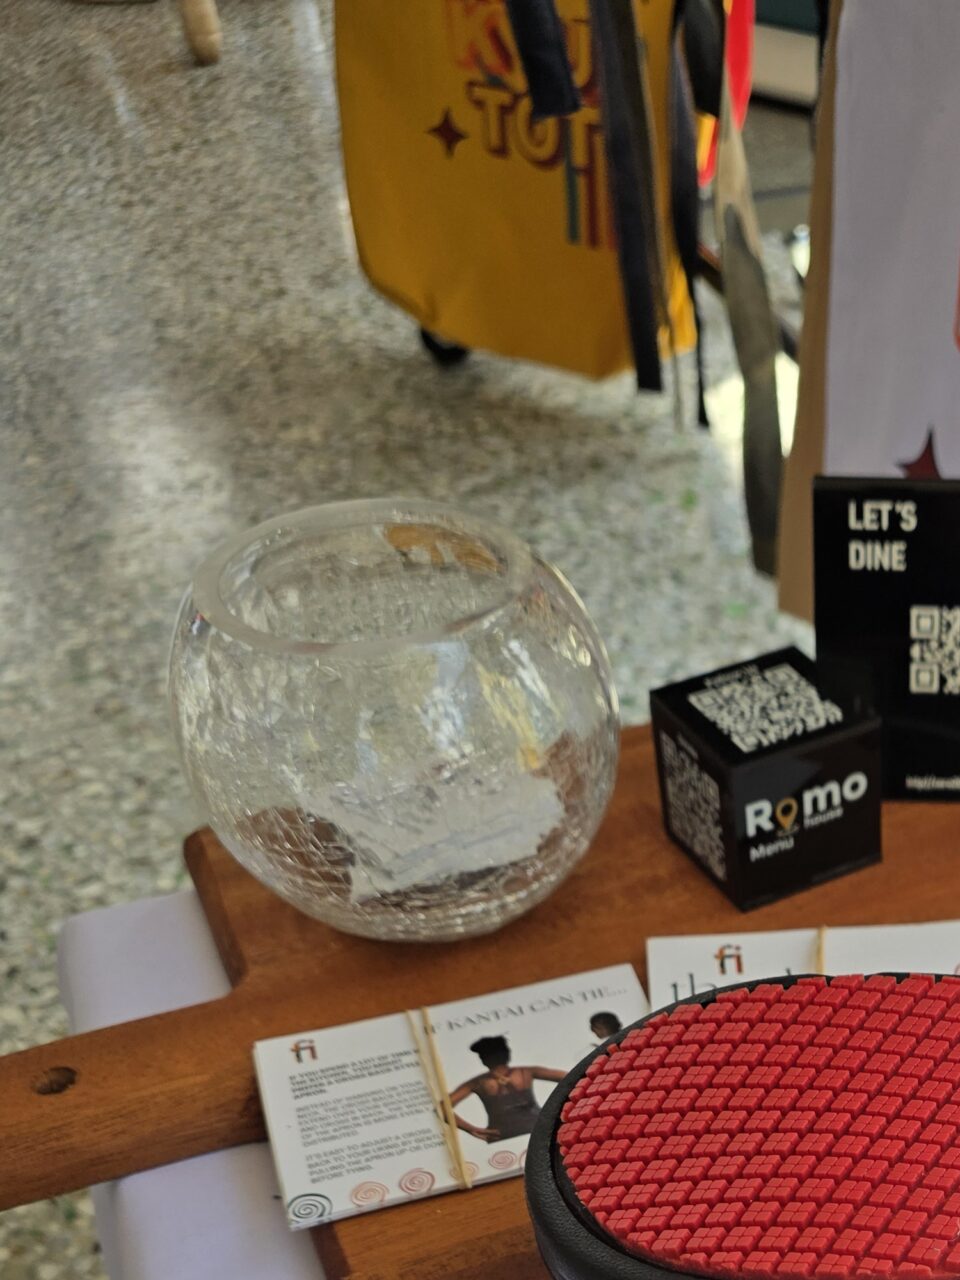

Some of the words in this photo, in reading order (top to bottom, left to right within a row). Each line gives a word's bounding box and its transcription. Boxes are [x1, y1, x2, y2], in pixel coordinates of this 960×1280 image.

[848, 500, 918, 532] LET'S
[848, 539, 907, 572] DINE
[749, 836, 794, 862] Menu
[529, 994, 572, 1012] CAN
